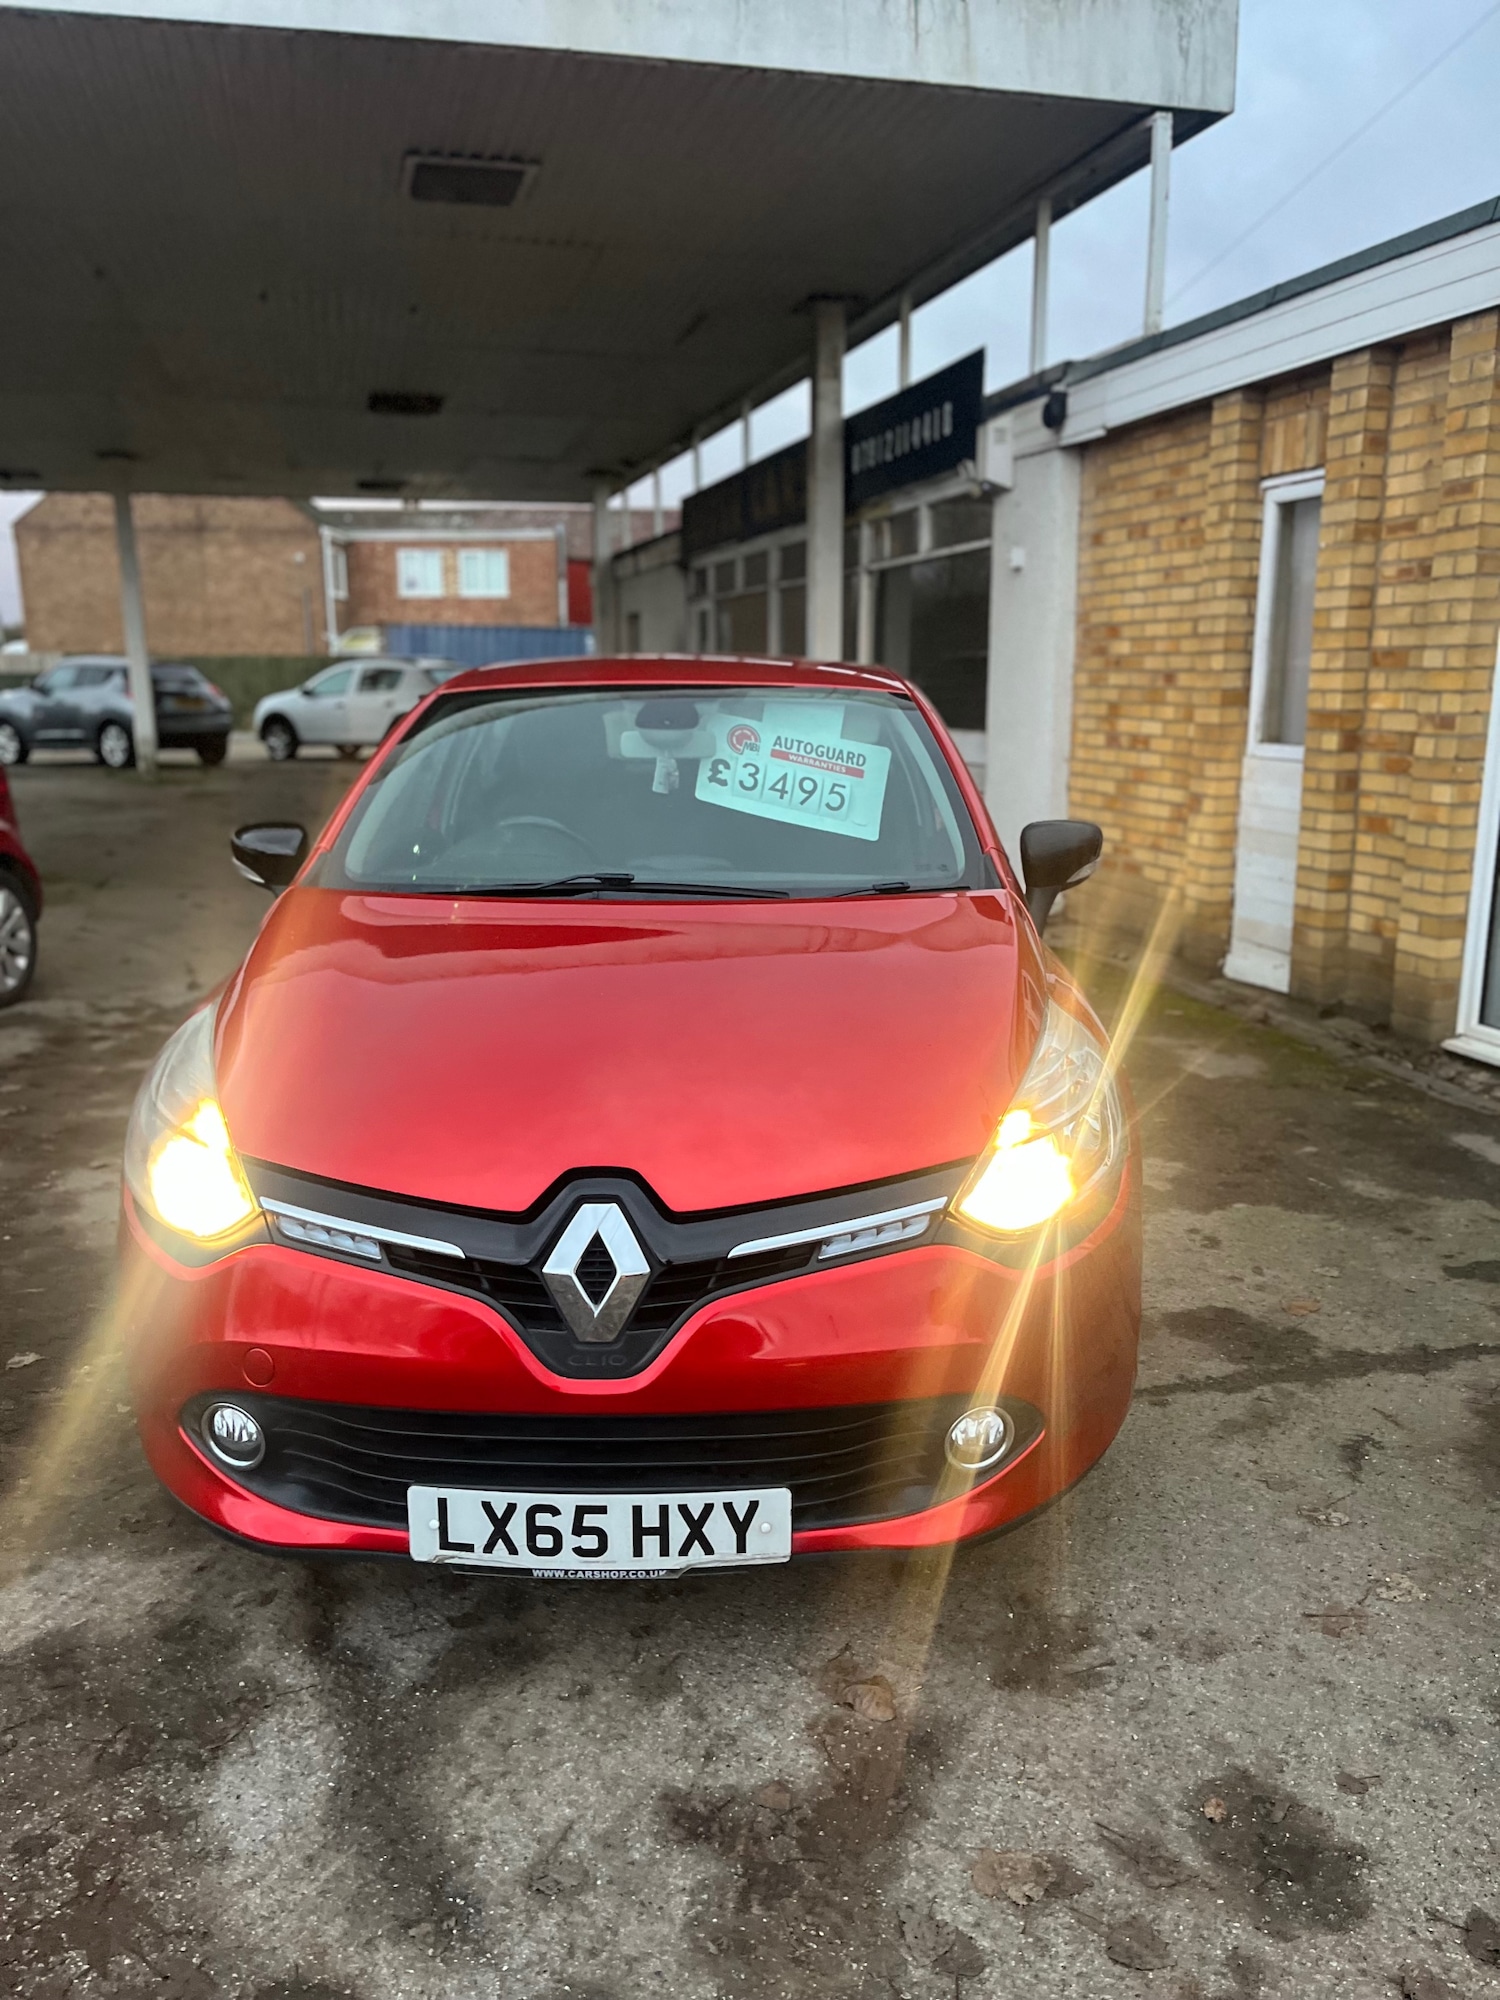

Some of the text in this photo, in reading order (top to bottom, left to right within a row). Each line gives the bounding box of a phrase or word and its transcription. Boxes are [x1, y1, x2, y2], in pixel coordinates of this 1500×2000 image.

[772, 735, 867, 767] AUTOGUARD
[788, 753, 847, 773] WARRANTIES
[707, 758, 847, 812] £3495
[567, 1354, 627, 1366] CLIO
[437, 1497, 760, 1558] LX65 HXY
